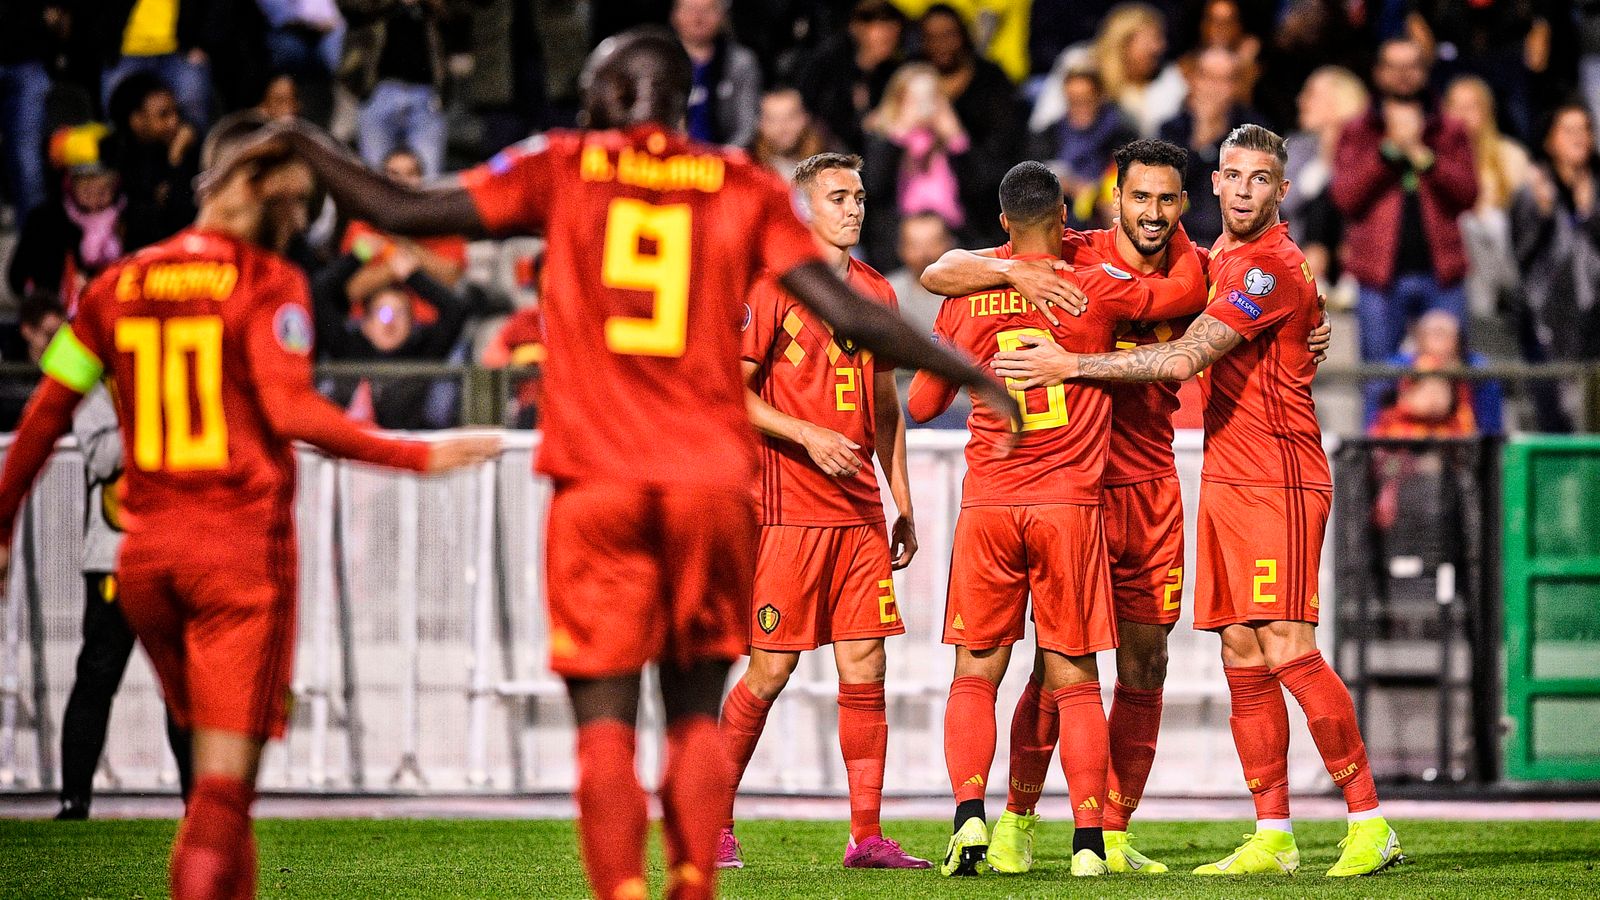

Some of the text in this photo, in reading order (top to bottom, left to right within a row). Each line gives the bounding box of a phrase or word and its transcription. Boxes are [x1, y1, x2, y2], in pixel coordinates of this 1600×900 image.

[601, 197, 692, 358] 9
[1236, 297, 1260, 317] RESPECT
[114, 315, 230, 472] 10
[835, 367, 864, 412] 21
[878, 579, 900, 624] 2
[1163, 567, 1182, 611] 2
[1253, 559, 1277, 602] 2
